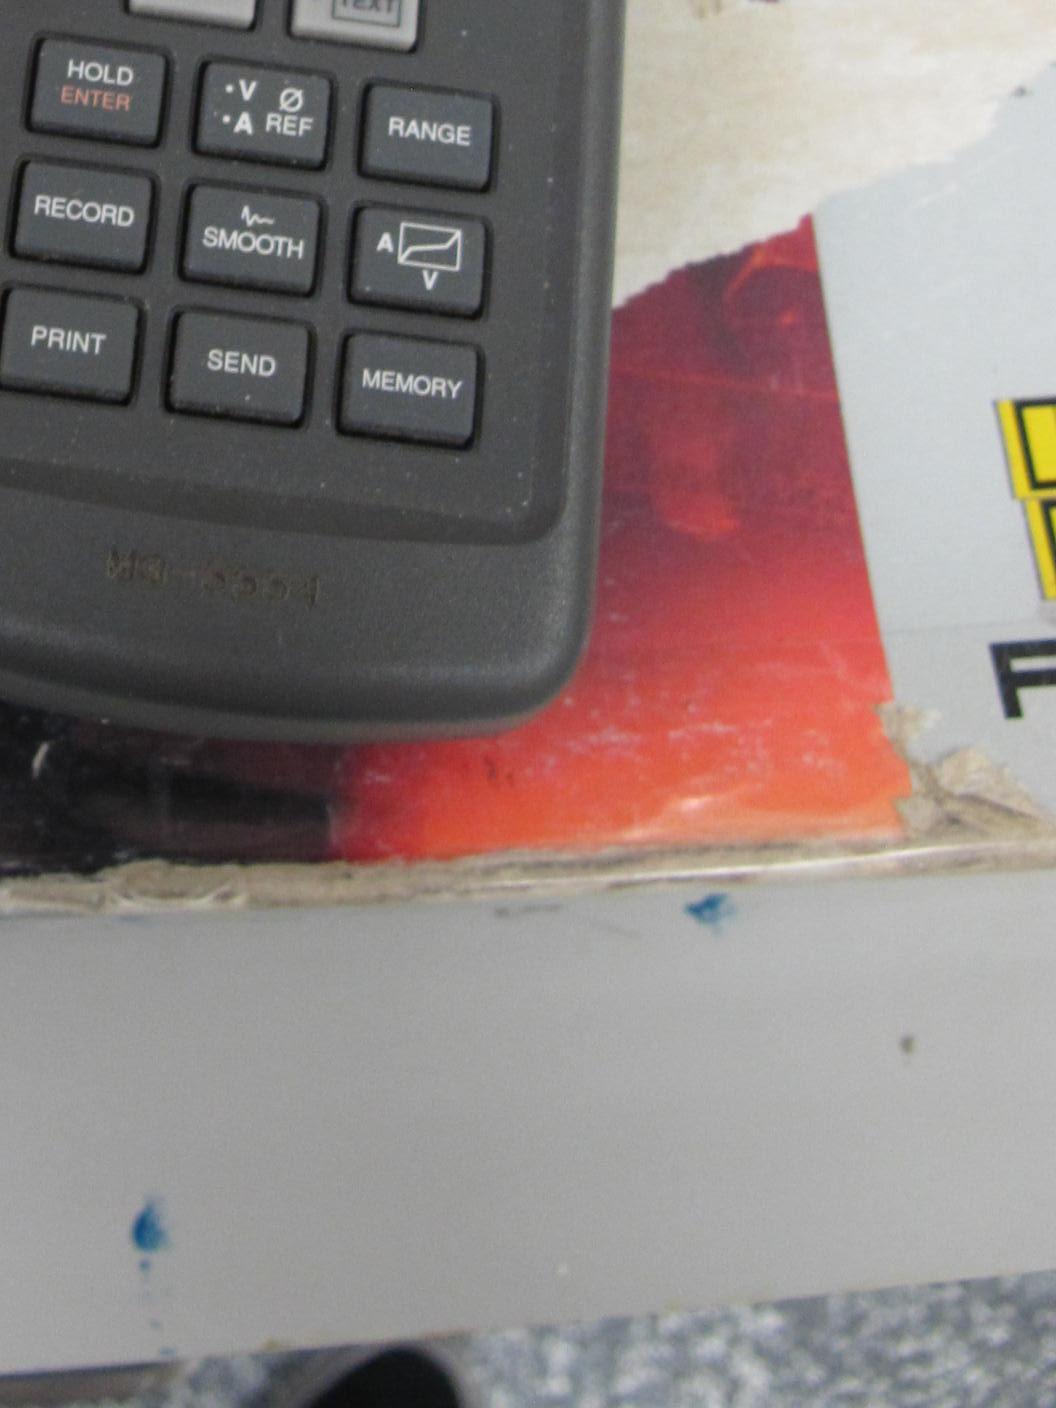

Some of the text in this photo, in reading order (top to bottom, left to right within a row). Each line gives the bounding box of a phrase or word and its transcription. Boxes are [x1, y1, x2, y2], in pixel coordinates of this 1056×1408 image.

[66, 58, 135, 88] HOLD
[60, 85, 132, 113] ENTER
[265, 114, 315, 139] REF
[387, 115, 472, 147] RANGE
[33, 194, 136, 228] RECORD
[201, 226, 305, 260] SMOOTH
[376, 232, 395, 253] A
[421, 269, 440, 291] V
[30, 325, 108, 355] PRINT
[206, 348, 277, 378] SEND
[361, 368, 463, 400] MEMORY
